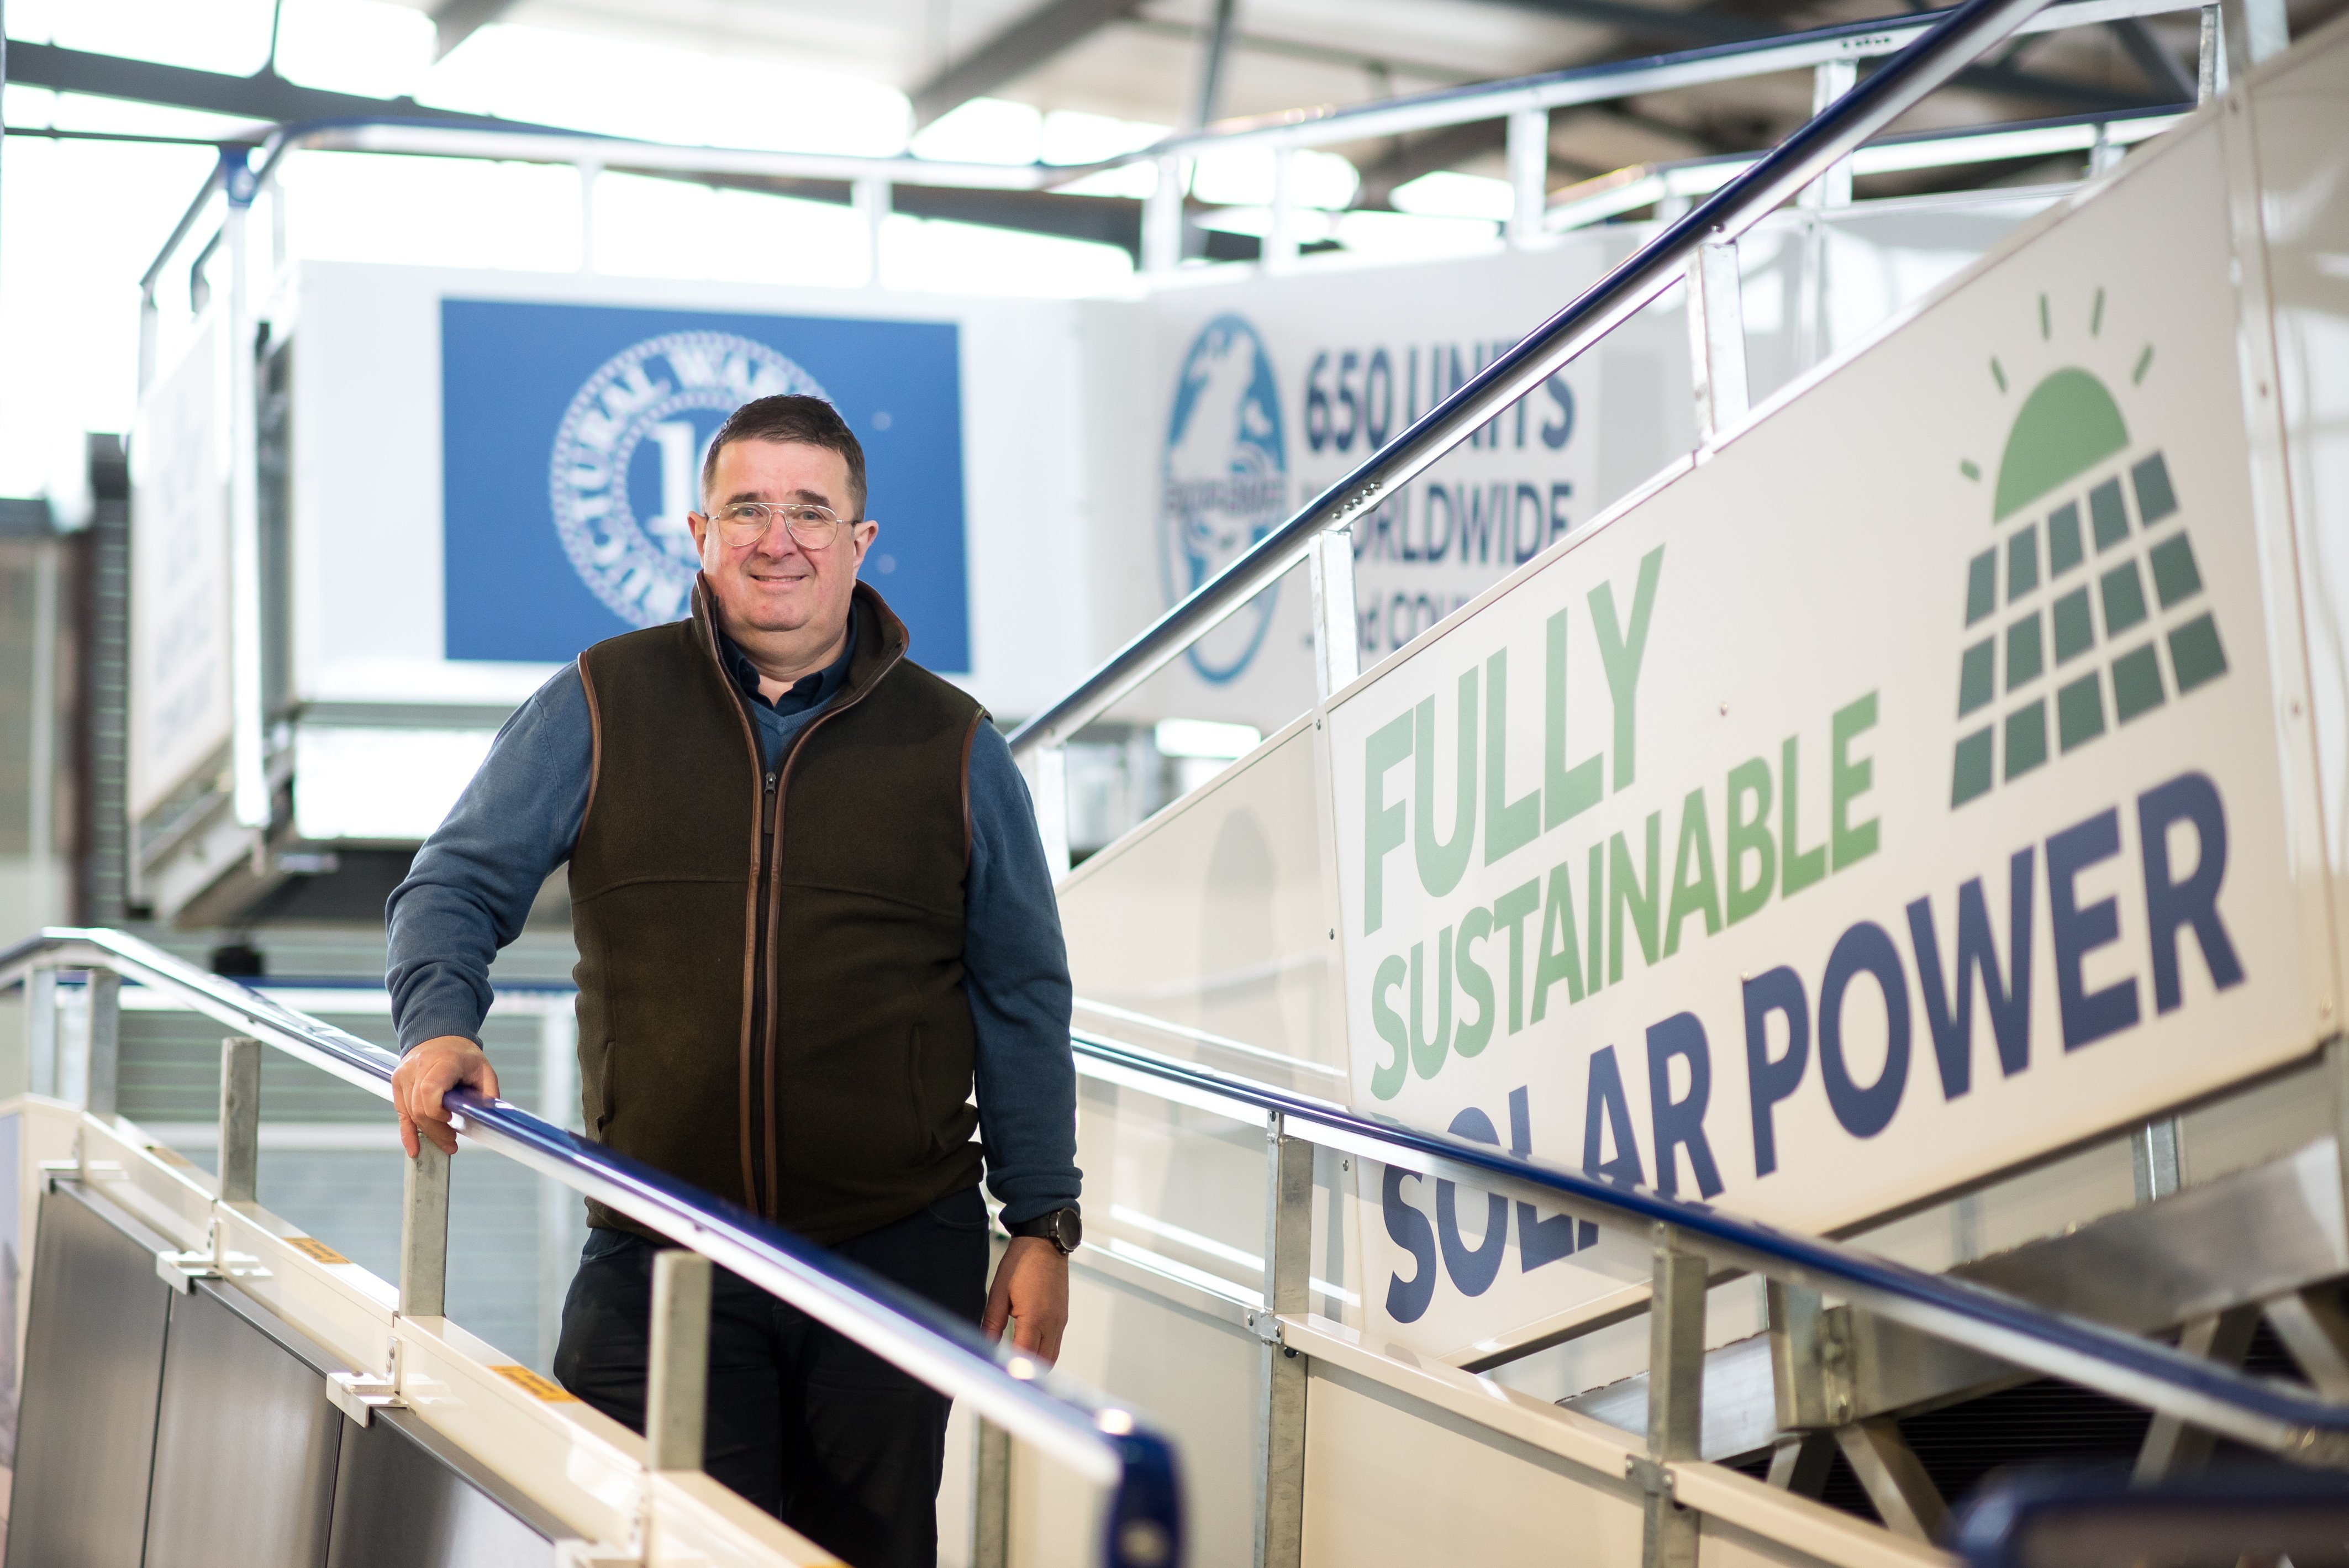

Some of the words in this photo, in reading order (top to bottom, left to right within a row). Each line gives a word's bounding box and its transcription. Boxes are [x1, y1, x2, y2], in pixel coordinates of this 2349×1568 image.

[1304, 346, 1393, 453] 650
[1365, 542, 1667, 938] FULLY
[1370, 687, 1882, 1101] SUSTAINABLE
[1382, 1011, 1726, 1324] SOLAR
[1741, 769, 2247, 1180] POWER
